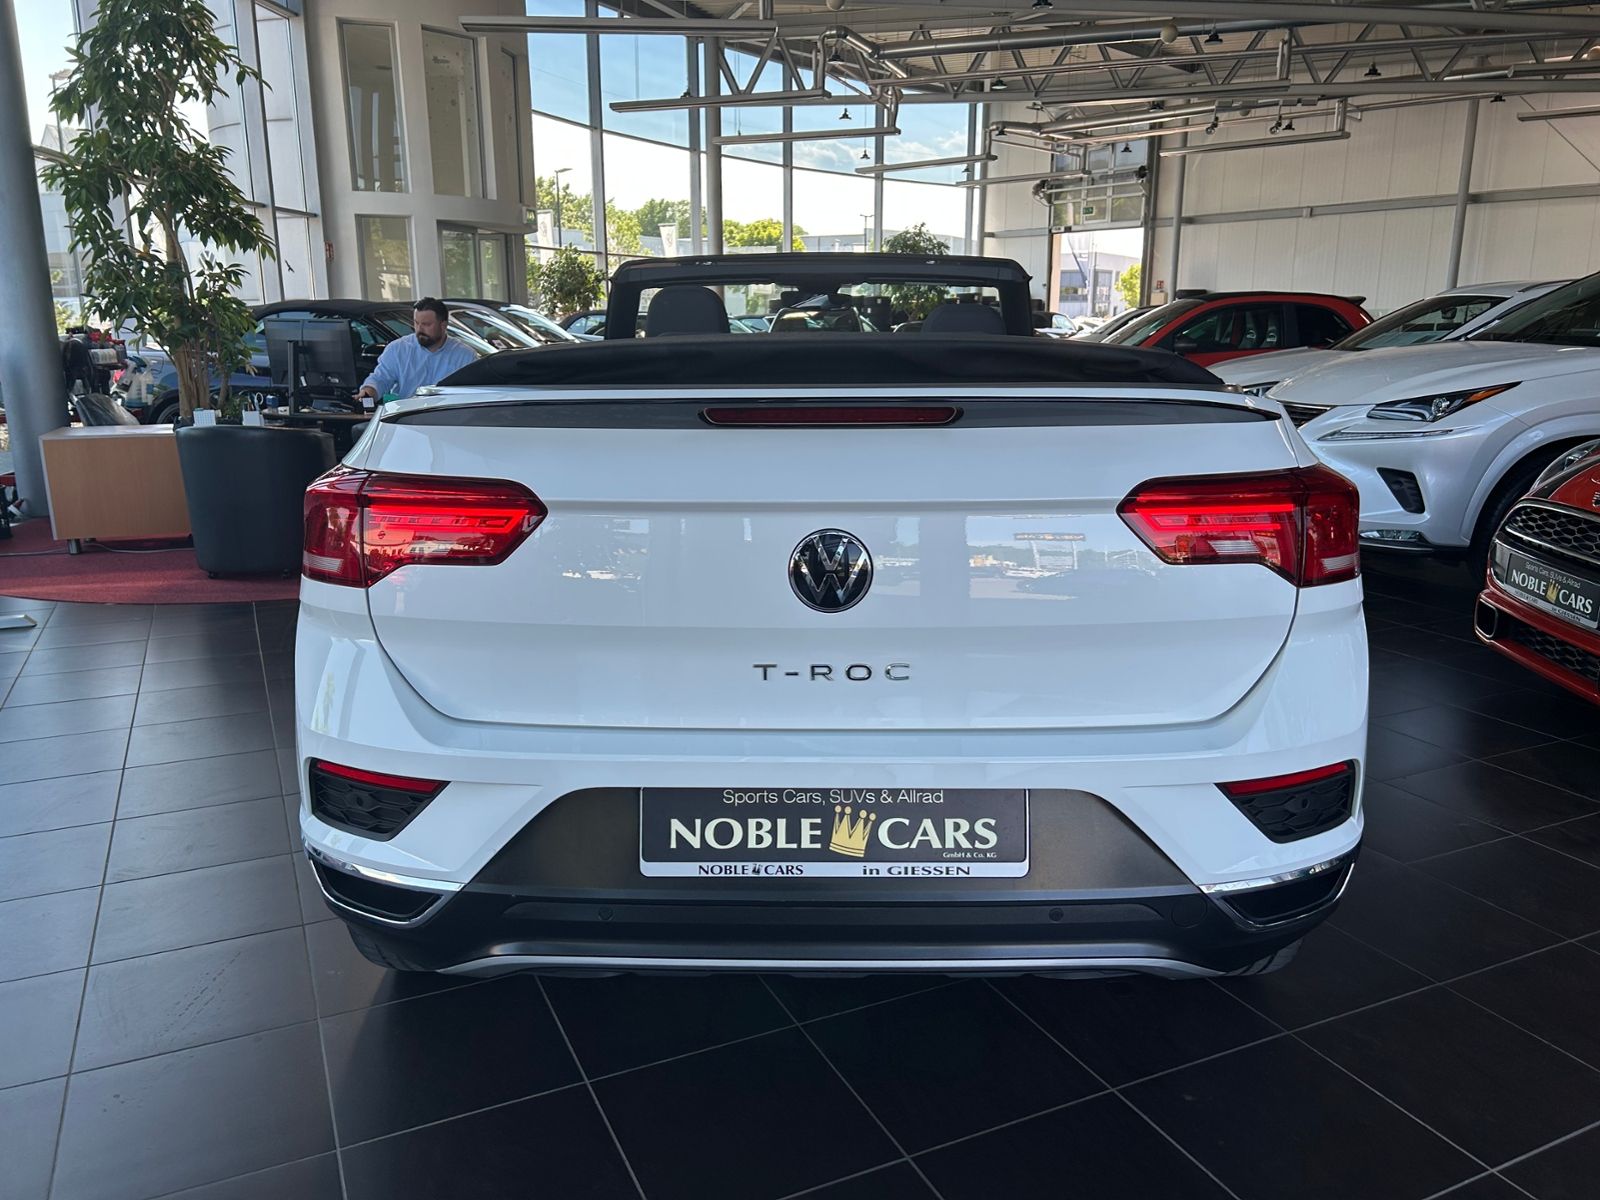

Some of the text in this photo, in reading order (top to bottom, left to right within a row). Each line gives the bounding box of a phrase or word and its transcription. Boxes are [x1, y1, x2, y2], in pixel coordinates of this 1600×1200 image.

[1511, 569, 1547, 595] NOBLE
[1559, 589, 1593, 614] CARS
[752, 663, 910, 682] T-ROC
[723, 789, 944, 806] Sports Cars, SUVs & Allrad
[670, 817, 998, 850] NOBLE CARS
[943, 851, 965, 859] GmbH
[986, 851, 997, 859] KG
[698, 864, 804, 876] NOBLE CARS
[862, 865, 970, 876] in GIESSEN
